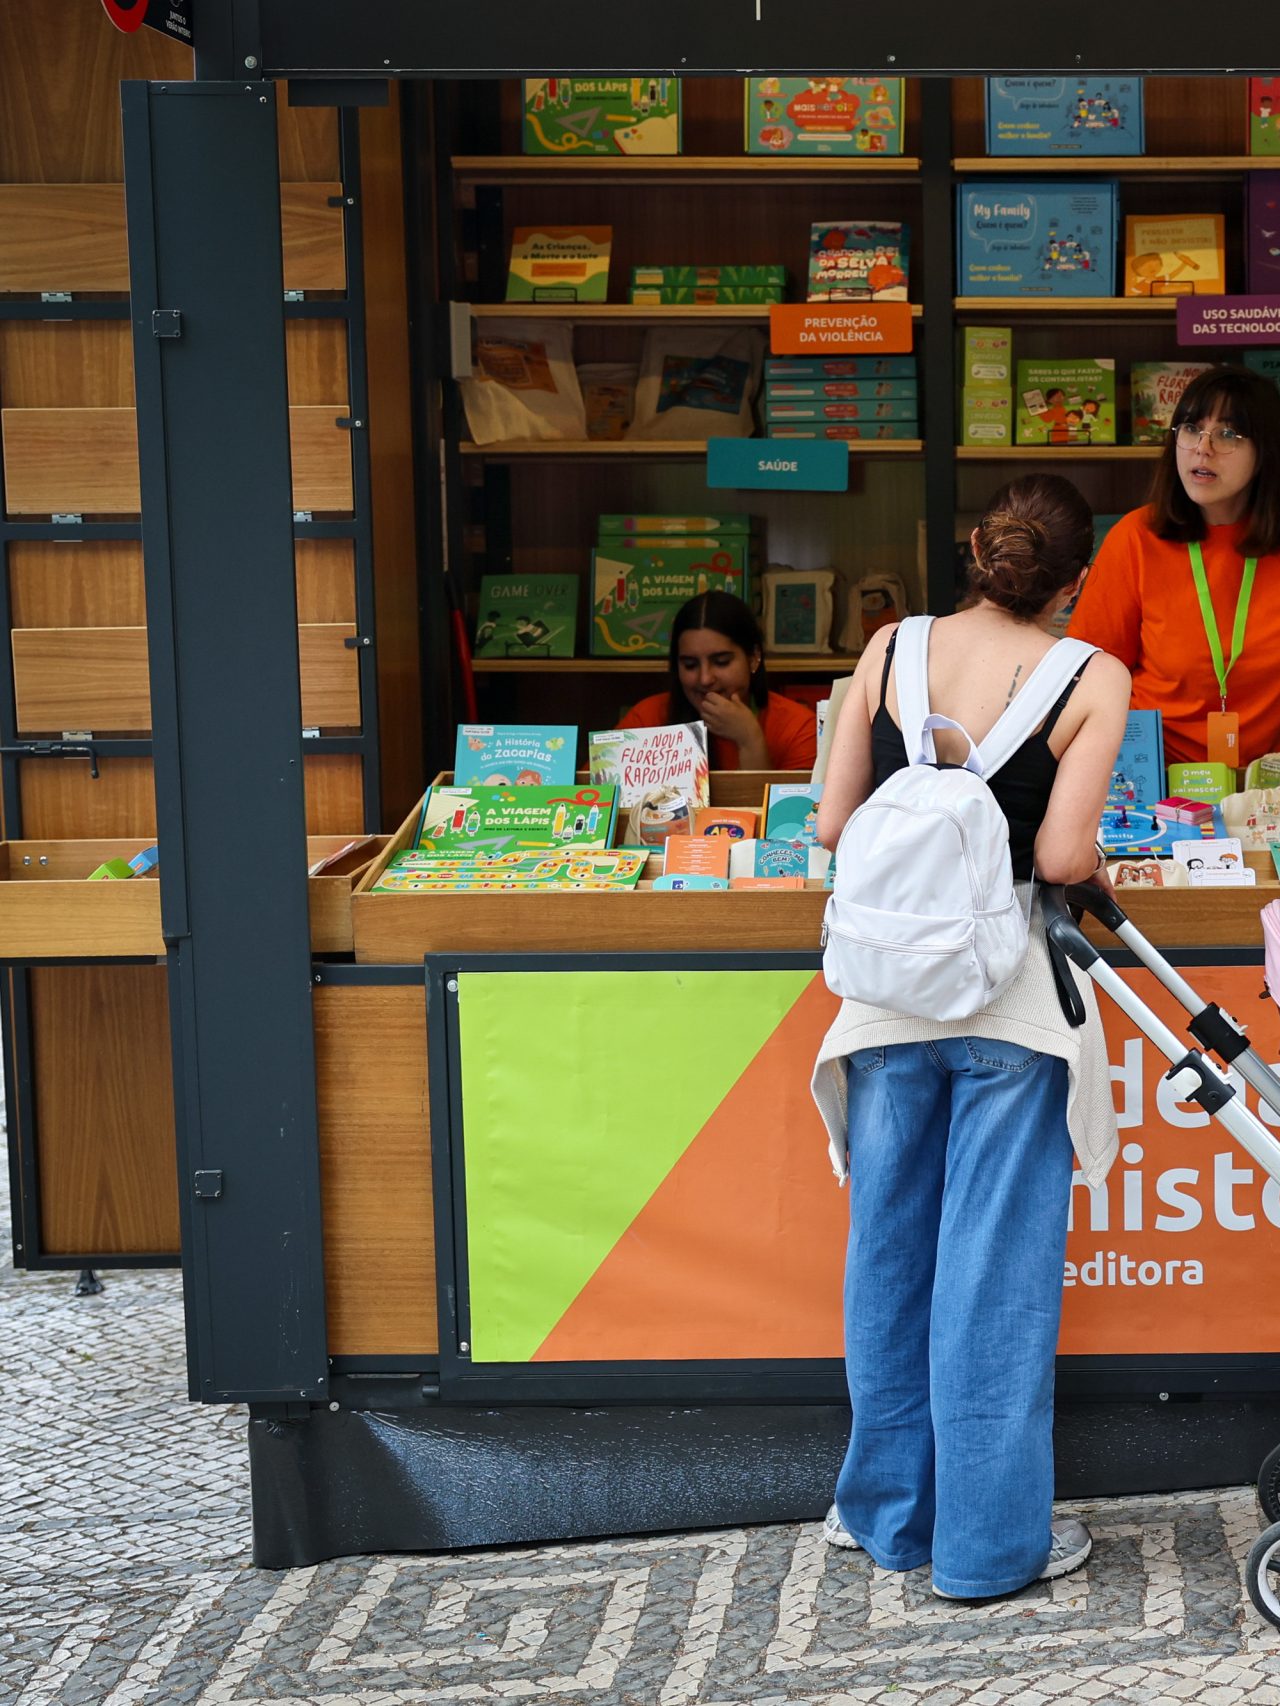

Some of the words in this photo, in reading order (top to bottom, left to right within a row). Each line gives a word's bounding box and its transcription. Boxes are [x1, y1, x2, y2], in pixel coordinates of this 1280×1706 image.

[575, 83, 595, 92] DOS
[599, 81, 628, 92] LÁPIS
[974, 204, 991, 220] My
[994, 203, 1031, 220] Family
[819, 258, 835, 268] DA
[836, 256, 888, 270] SELVA
[816, 269, 868, 280] MORREU
[1203, 310, 1228, 320] USO
[804, 316, 877, 329] PREVENÇÃO
[1192, 324, 1218, 334] DAS
[800, 333, 816, 342] DA
[818, 330, 884, 342] VIOLÊNCIA
[758, 459, 798, 471] SAÚDE
[642, 575, 650, 584] A
[654, 574, 694, 584] VIAGEM
[491, 585, 528, 598] GAME
[642, 587, 663, 596] DOS
[665, 585, 695, 596] LÁPIS
[505, 738, 540, 747] História
[643, 738, 649, 748] A
[651, 731, 683, 748] NOVA
[481, 752, 492, 761] do
[495, 748, 552, 762] Zacarias
[621, 747, 679, 766] FLORESTA
[683, 746, 693, 757] DA
[624, 758, 692, 788] RAPOSINHA
[501, 807, 552, 816] VIAGEM
[514, 816, 550, 825] LÁPIS
[1062, 1251, 1204, 1286] editora
